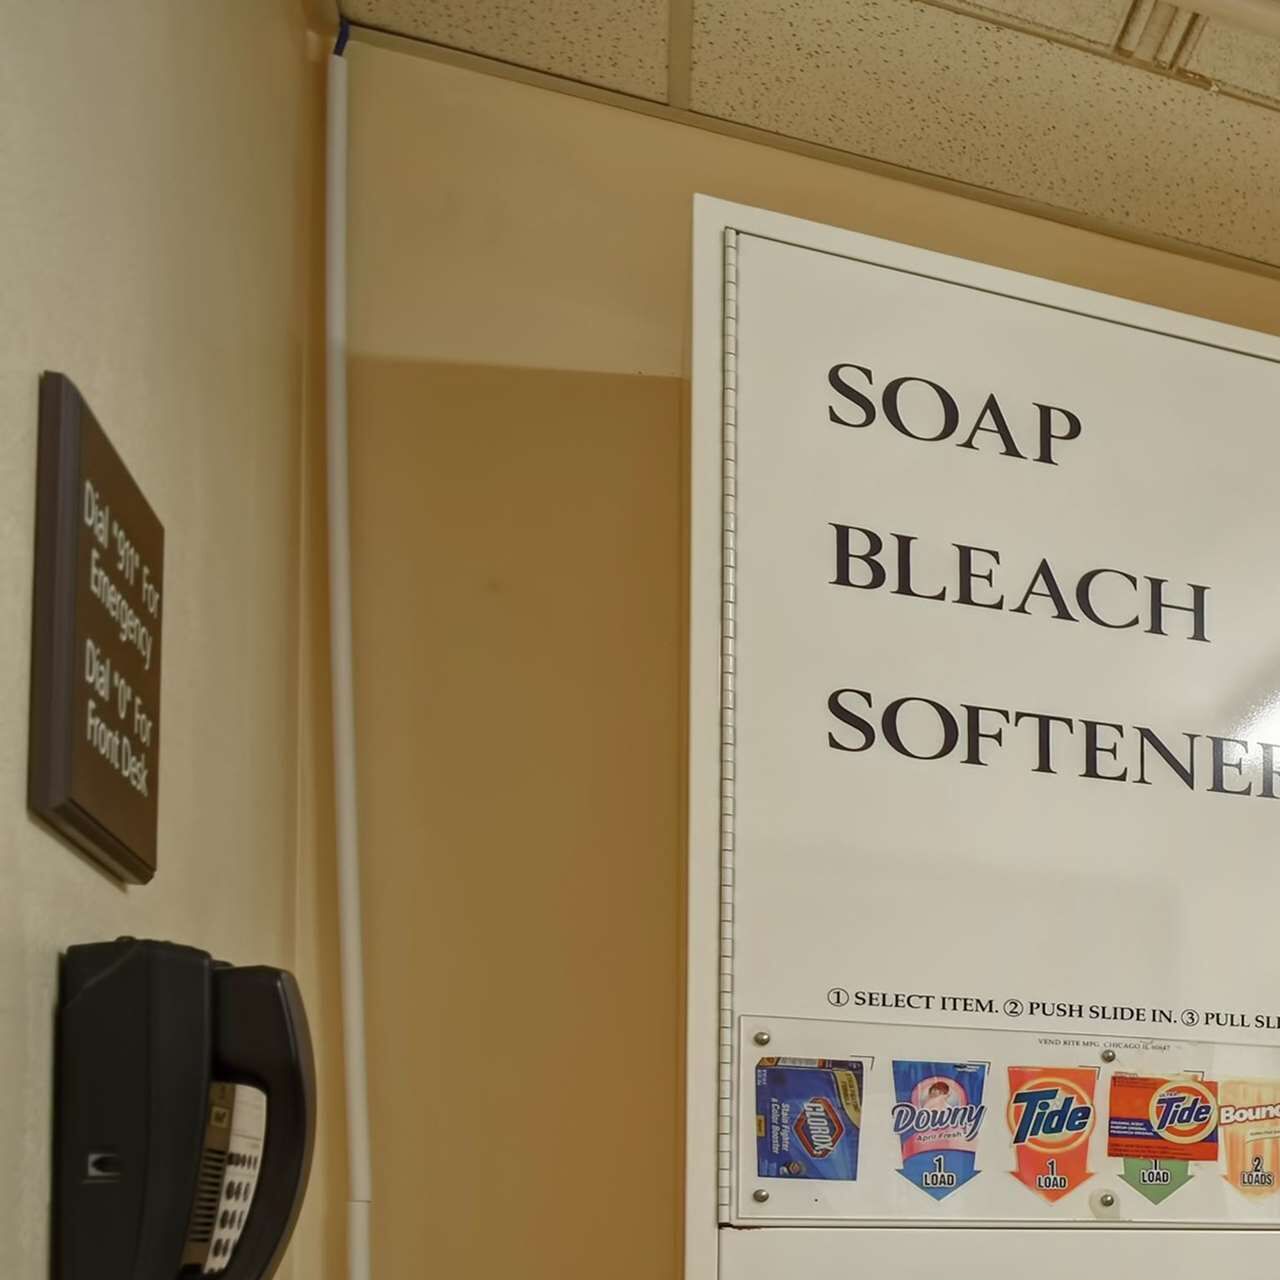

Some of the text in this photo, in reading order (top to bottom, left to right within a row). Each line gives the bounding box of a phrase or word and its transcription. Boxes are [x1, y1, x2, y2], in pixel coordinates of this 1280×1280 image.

[827, 362, 1083, 466] SOAP
[84, 479, 160, 619] Dial "911" For
[827, 521, 1212, 643] BLEACH
[89, 548, 153, 671] Emergency
[84, 637, 152, 747] Dial "0" For
[86, 698, 149, 798] Front Desk
[854, 991, 936, 1010] SELECT
[940, 996, 1000, 1014] ITEM.
[1029, 1001, 1084, 1018] PUSH
[1088, 1004, 1147, 1022] SLIDE
[1151, 1008, 1178, 1024] IN.
[1204, 1011, 1251, 1028] PULL
[1038, 1037, 1062, 1046] VEND
[1103, 1041, 1141, 1050] CHICAGO
[771, 1103, 780, 1124] Color
[780, 1103, 791, 1152] Stain Fighter
[803, 1102, 834, 1152] CLOROX
[891, 1103, 986, 1142] Downy
[1013, 1088, 1092, 1144] Tide
[1157, 1096, 1212, 1131] Tide
[771, 1125, 780, 1154] Booster
[924, 1174, 954, 1186] LOAD
[934, 1157, 944, 1172] 1
[1038, 1176, 1067, 1188] LOAD
[1047, 1161, 1056, 1175] 1
[1142, 1172, 1169, 1183] LOAD
[1242, 1173, 1272, 1185] LOADS
[1253, 1157, 1263, 1171] 2
